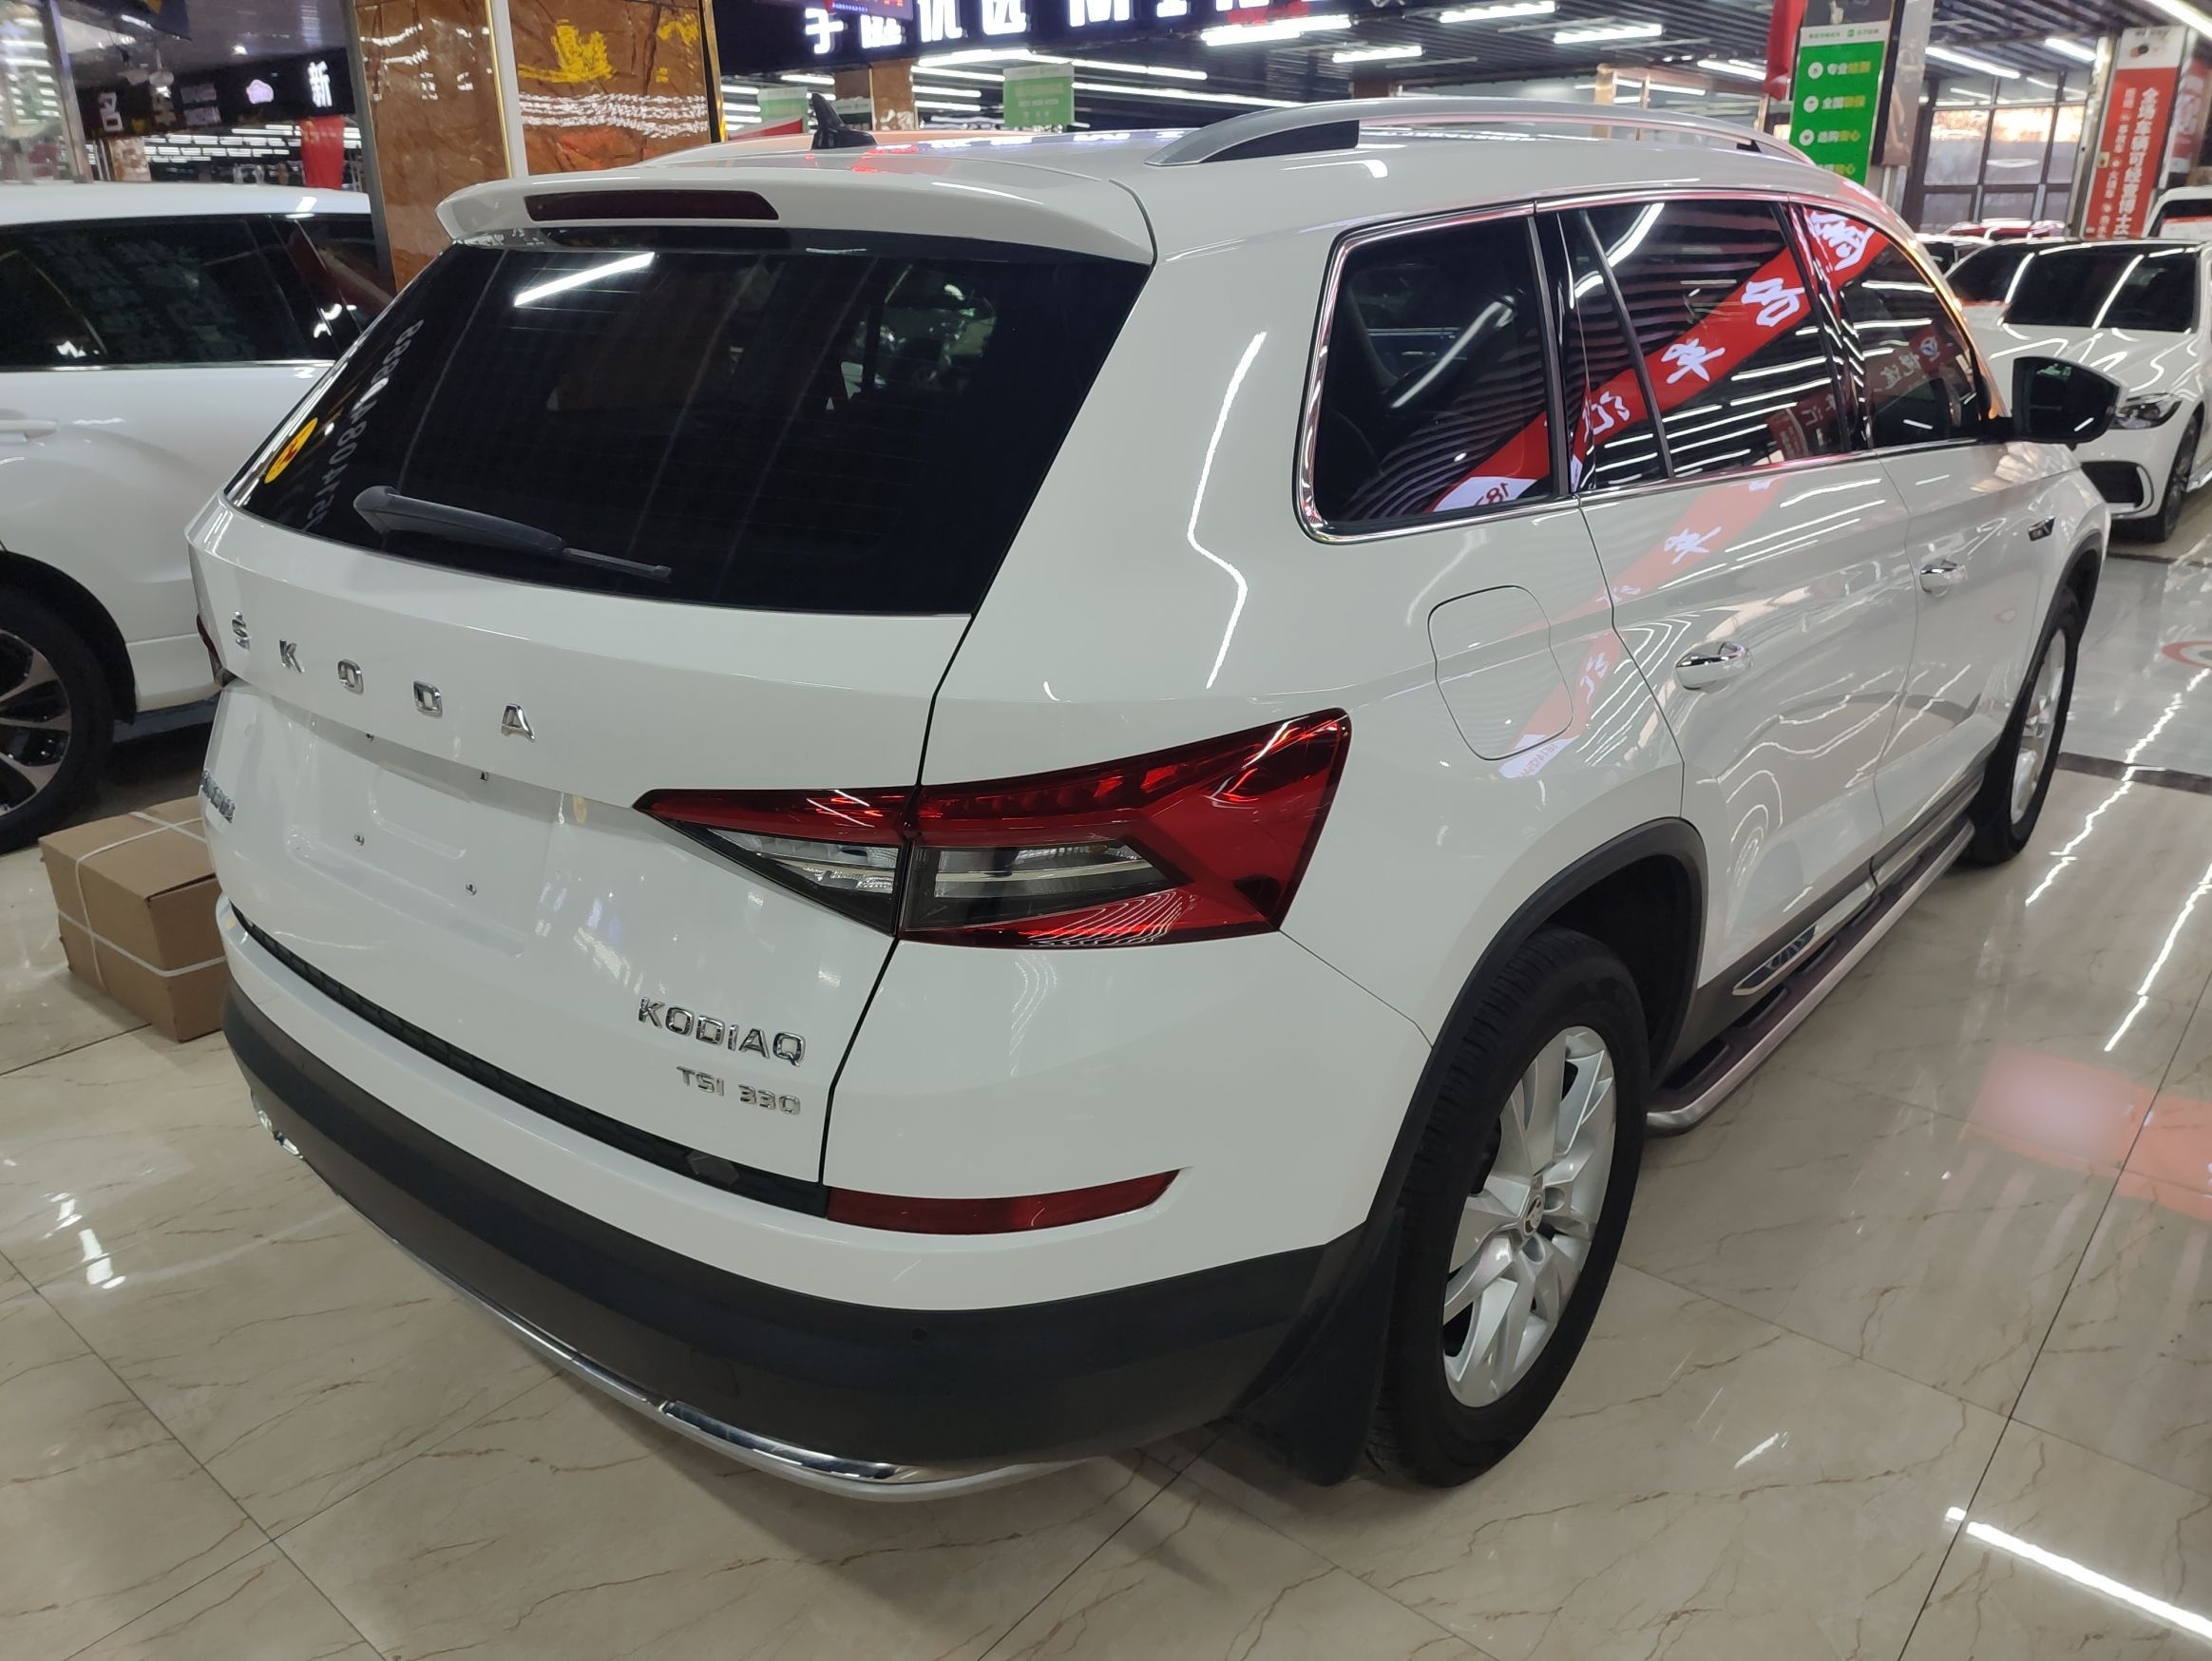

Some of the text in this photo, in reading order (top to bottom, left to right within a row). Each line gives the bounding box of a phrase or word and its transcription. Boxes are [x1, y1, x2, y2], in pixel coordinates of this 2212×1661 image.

[639, 997, 807, 1067] KODIAQ
[676, 1065, 800, 1116] TSI 330
